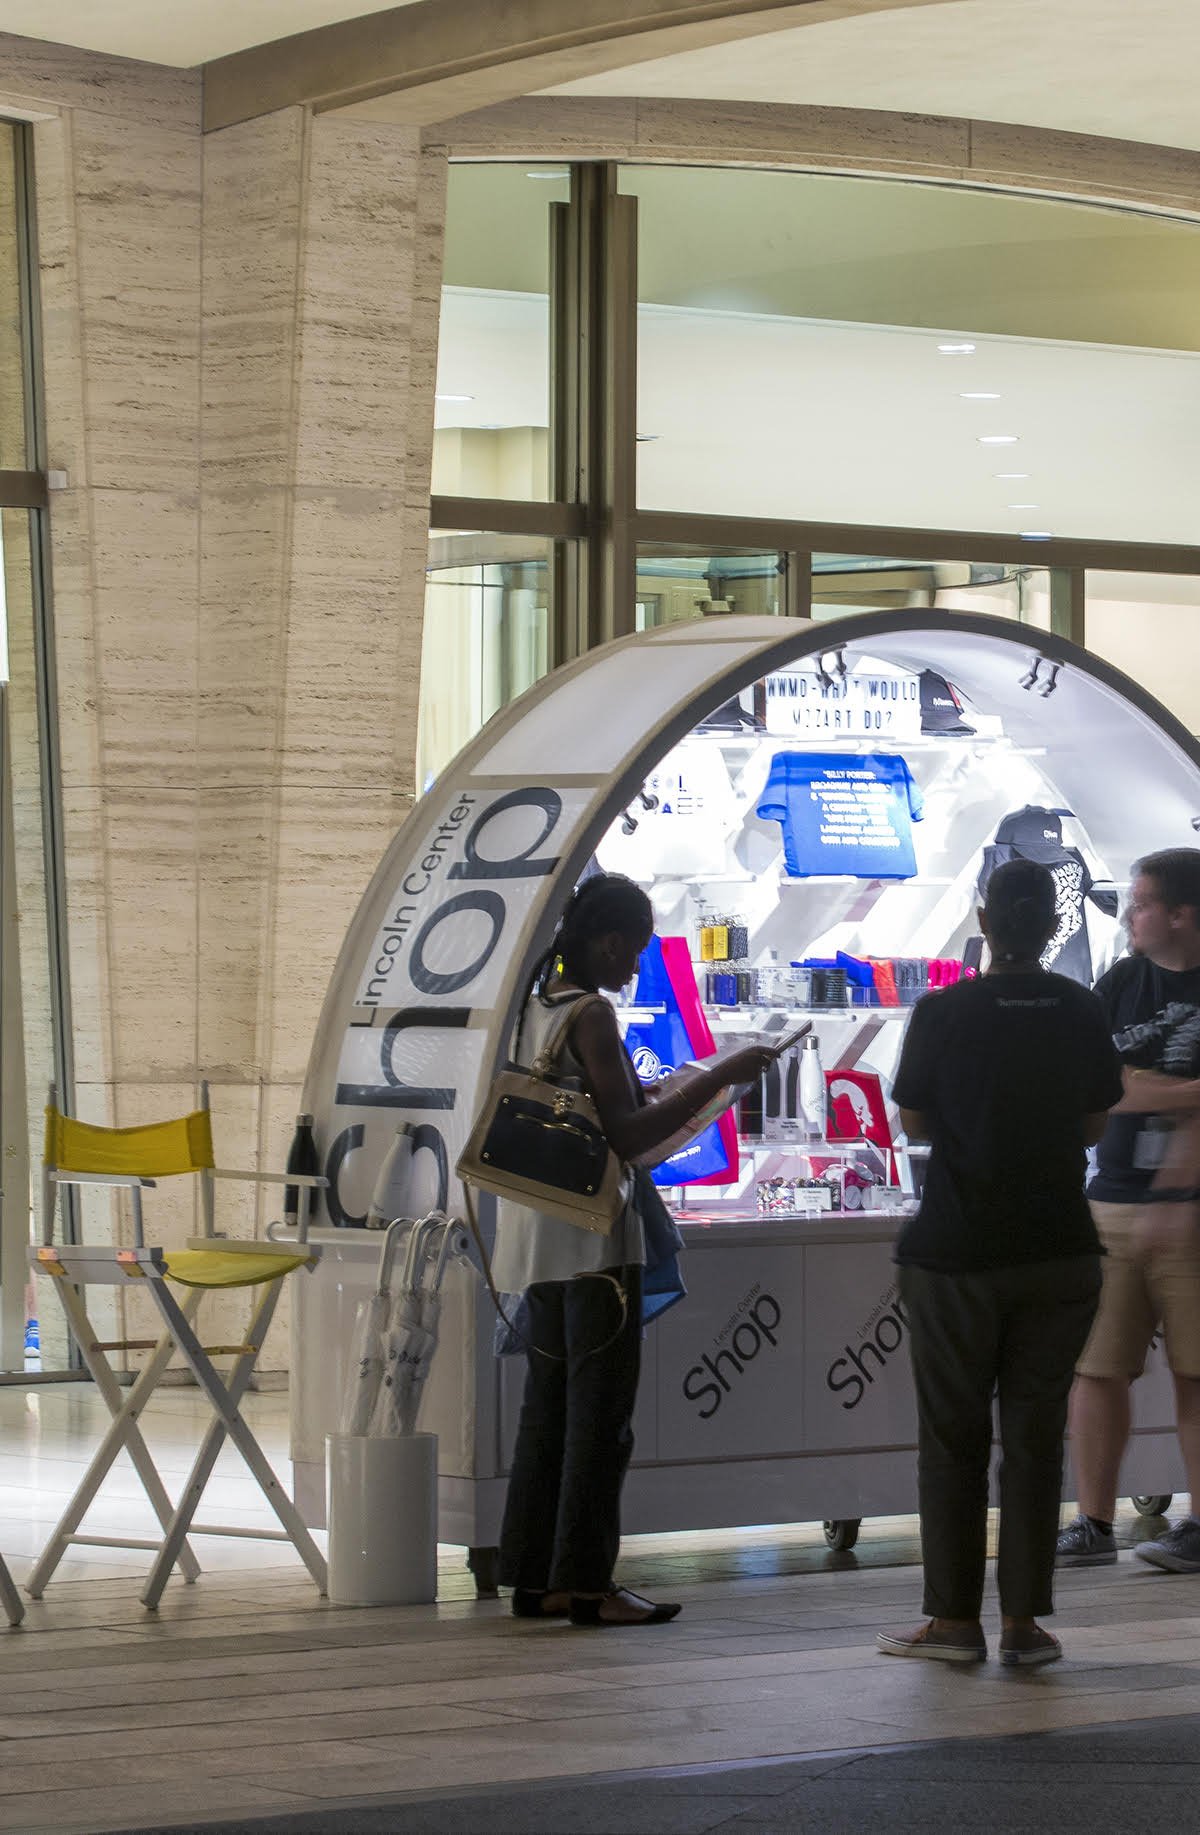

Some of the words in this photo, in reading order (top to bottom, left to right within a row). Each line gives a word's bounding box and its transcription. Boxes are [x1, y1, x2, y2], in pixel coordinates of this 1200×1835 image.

[868, 680, 917, 700] WOULD
[349, 905, 417, 1029] Lincoln
[402, 792, 478, 897] Center
[325, 785, 564, 1229] Shop
[682, 1294, 782, 1420] Shop
